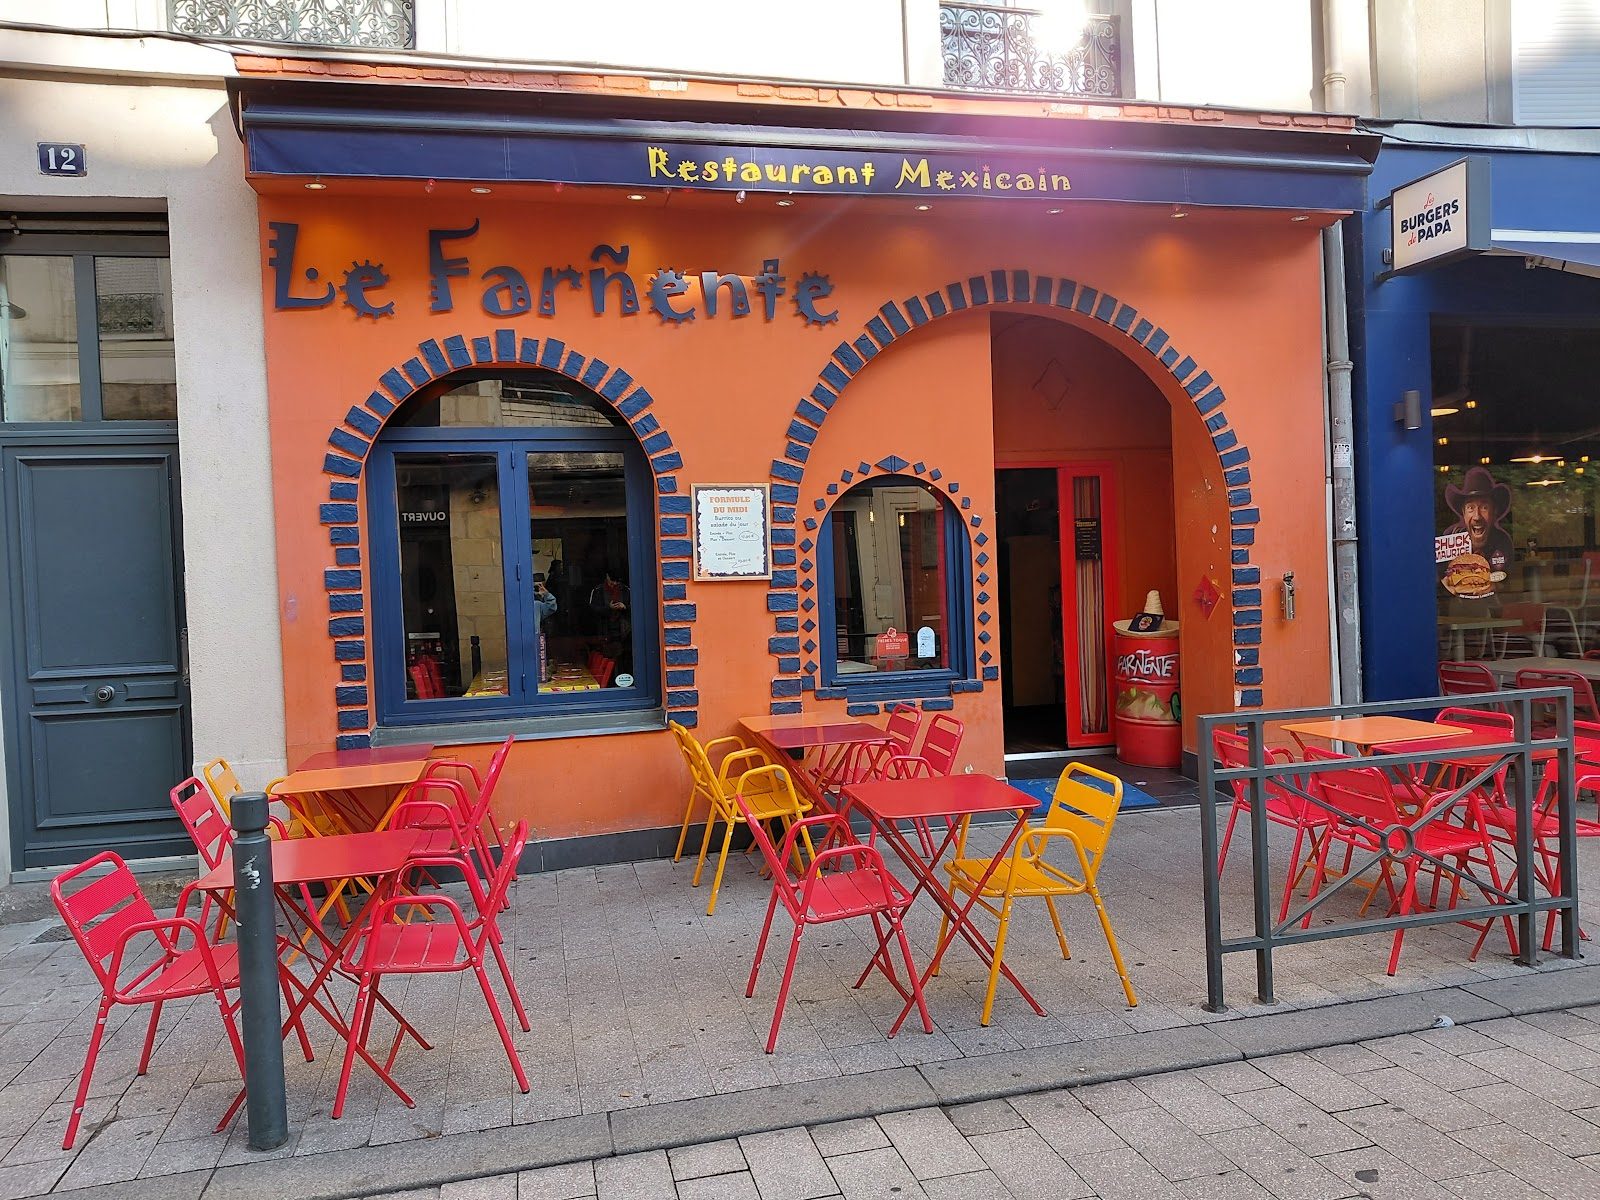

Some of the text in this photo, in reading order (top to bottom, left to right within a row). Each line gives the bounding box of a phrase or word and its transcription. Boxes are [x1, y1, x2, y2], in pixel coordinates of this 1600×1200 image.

[47, 147, 76, 171] 12
[647, 145, 1073, 192] Restaurant Mexicain
[1400, 199, 1459, 234] BURGERS
[1407, 219, 1452, 247] de PAPA
[268, 217, 841, 327] Le Farñente
[737, 521, 749, 529] jour
[1434, 534, 1471, 552] CHUCK
